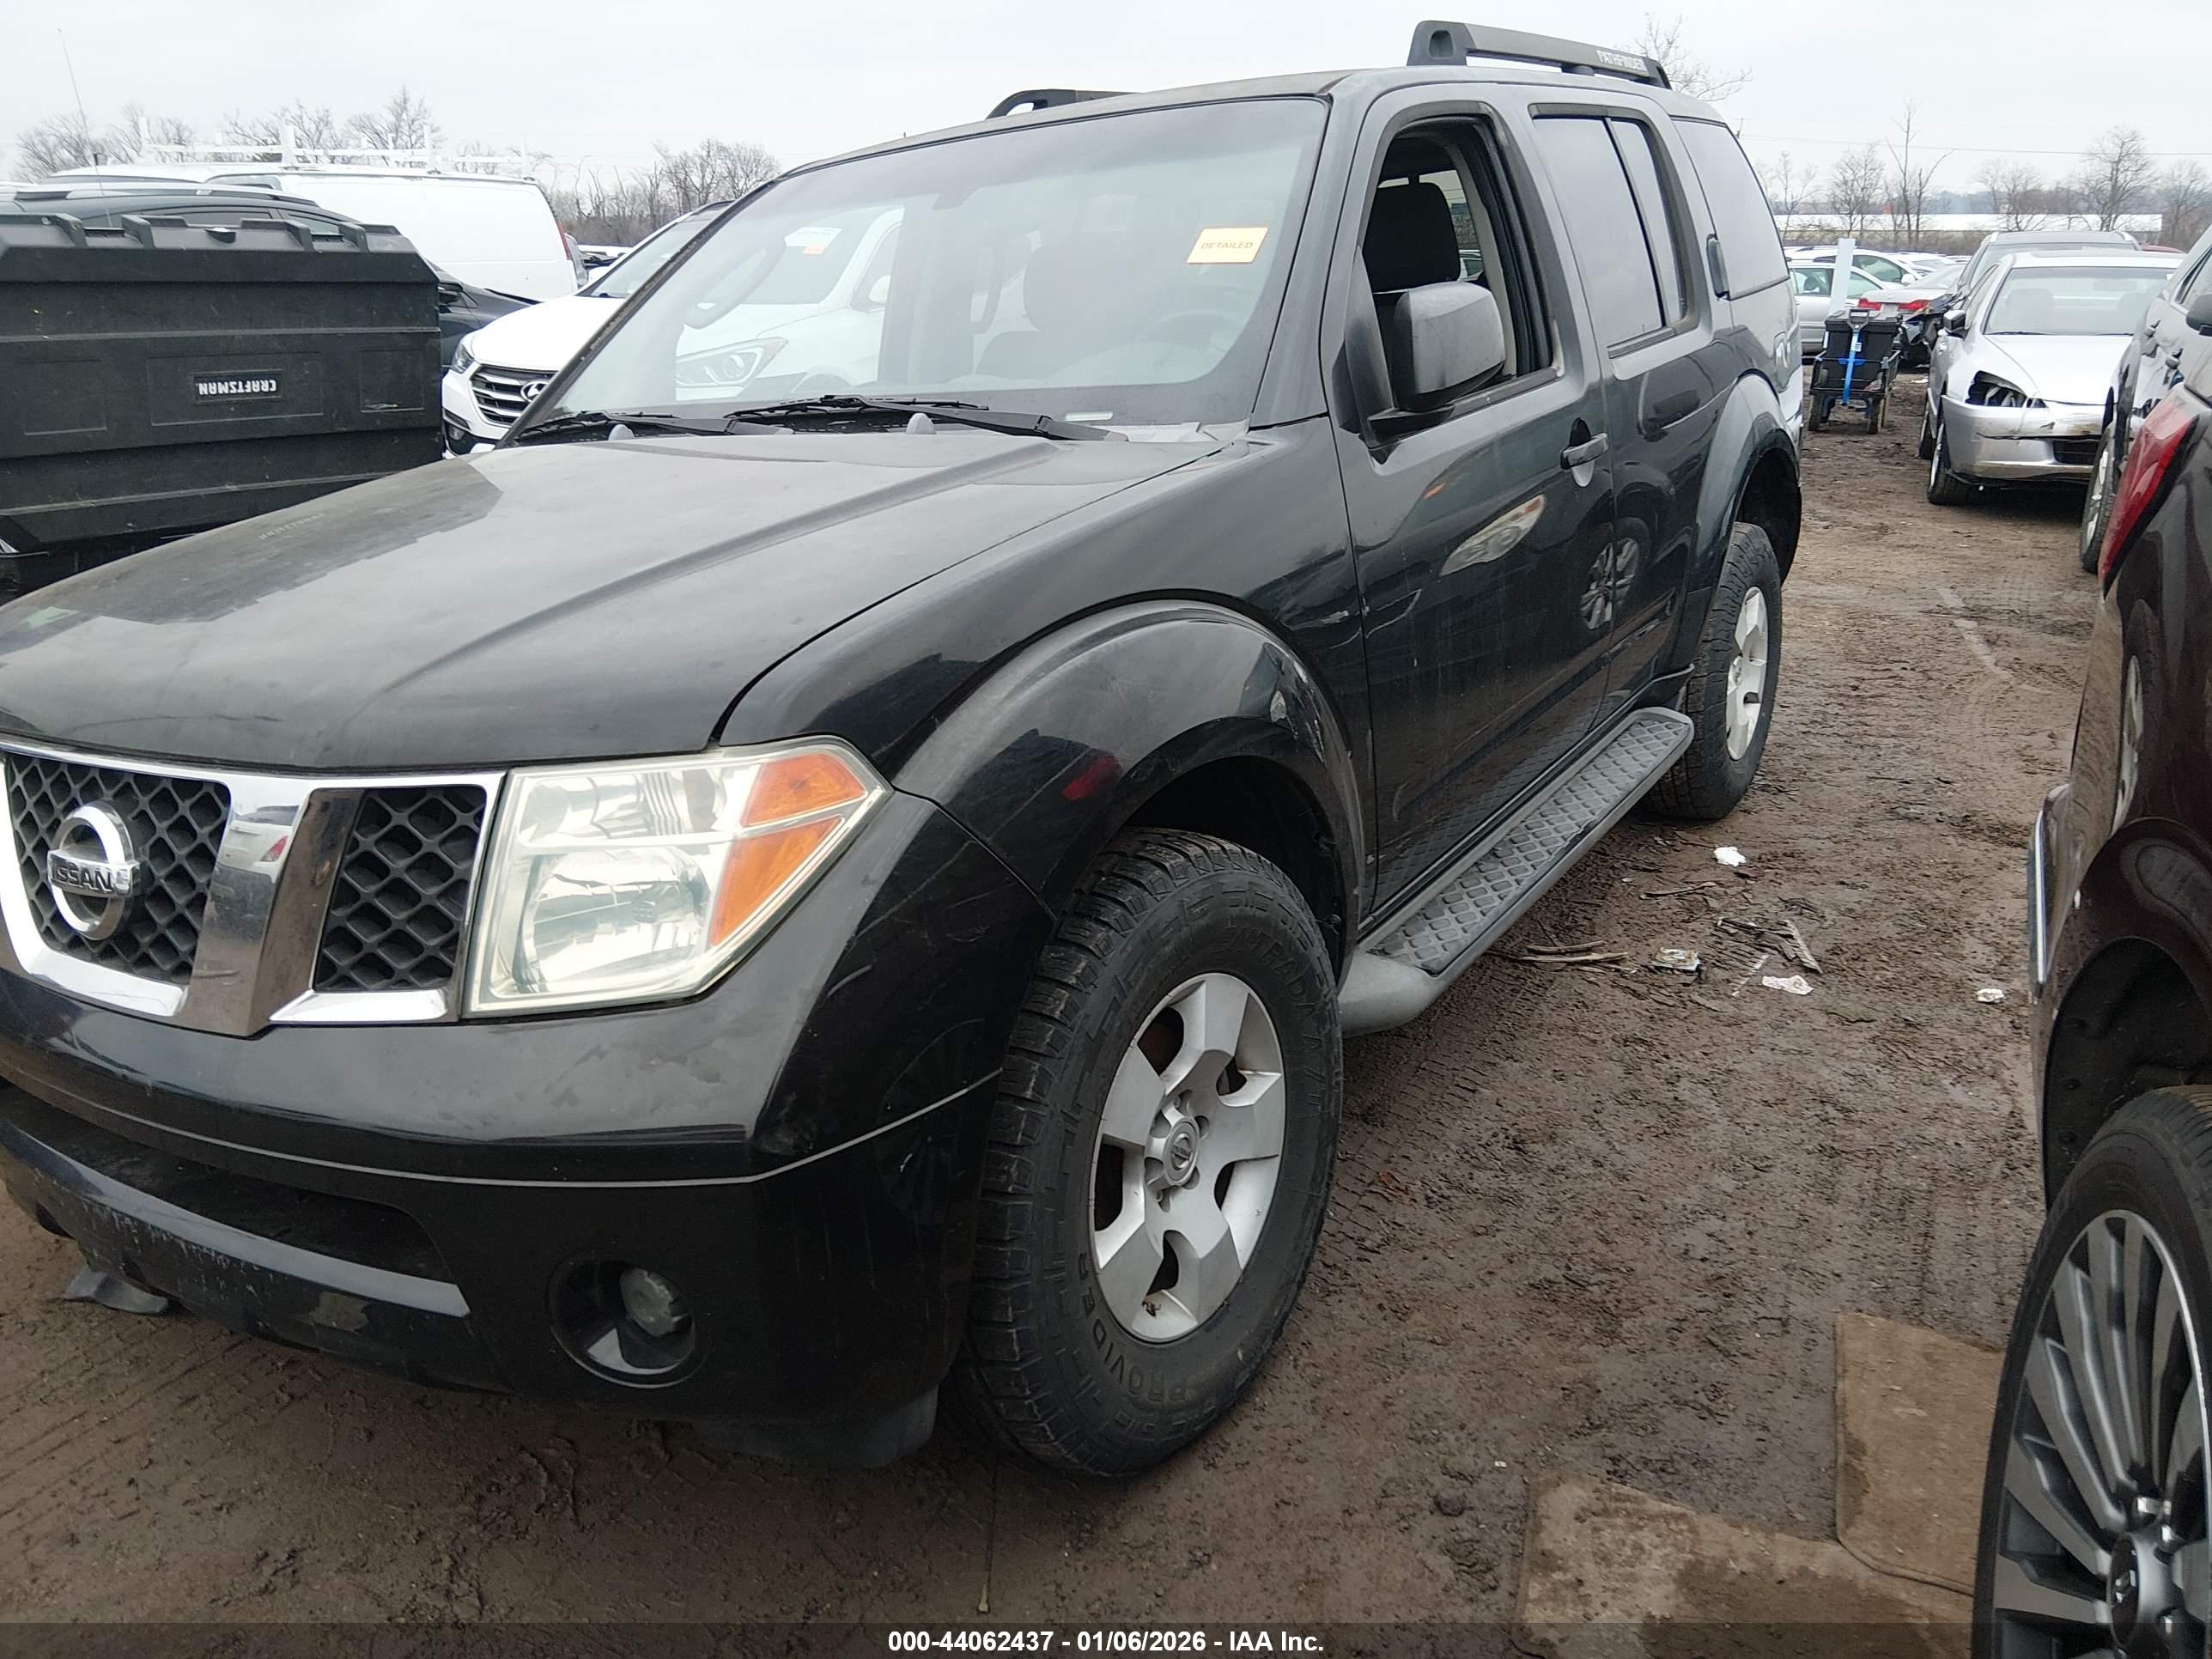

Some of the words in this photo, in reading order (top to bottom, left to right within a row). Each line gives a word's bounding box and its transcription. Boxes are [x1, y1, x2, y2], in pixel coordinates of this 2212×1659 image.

[1200, 241, 1254, 250] DETAILED
[198, 379, 277, 396] CRAFTSMAN
[1078, 1250, 1188, 1403] PROVIDER
